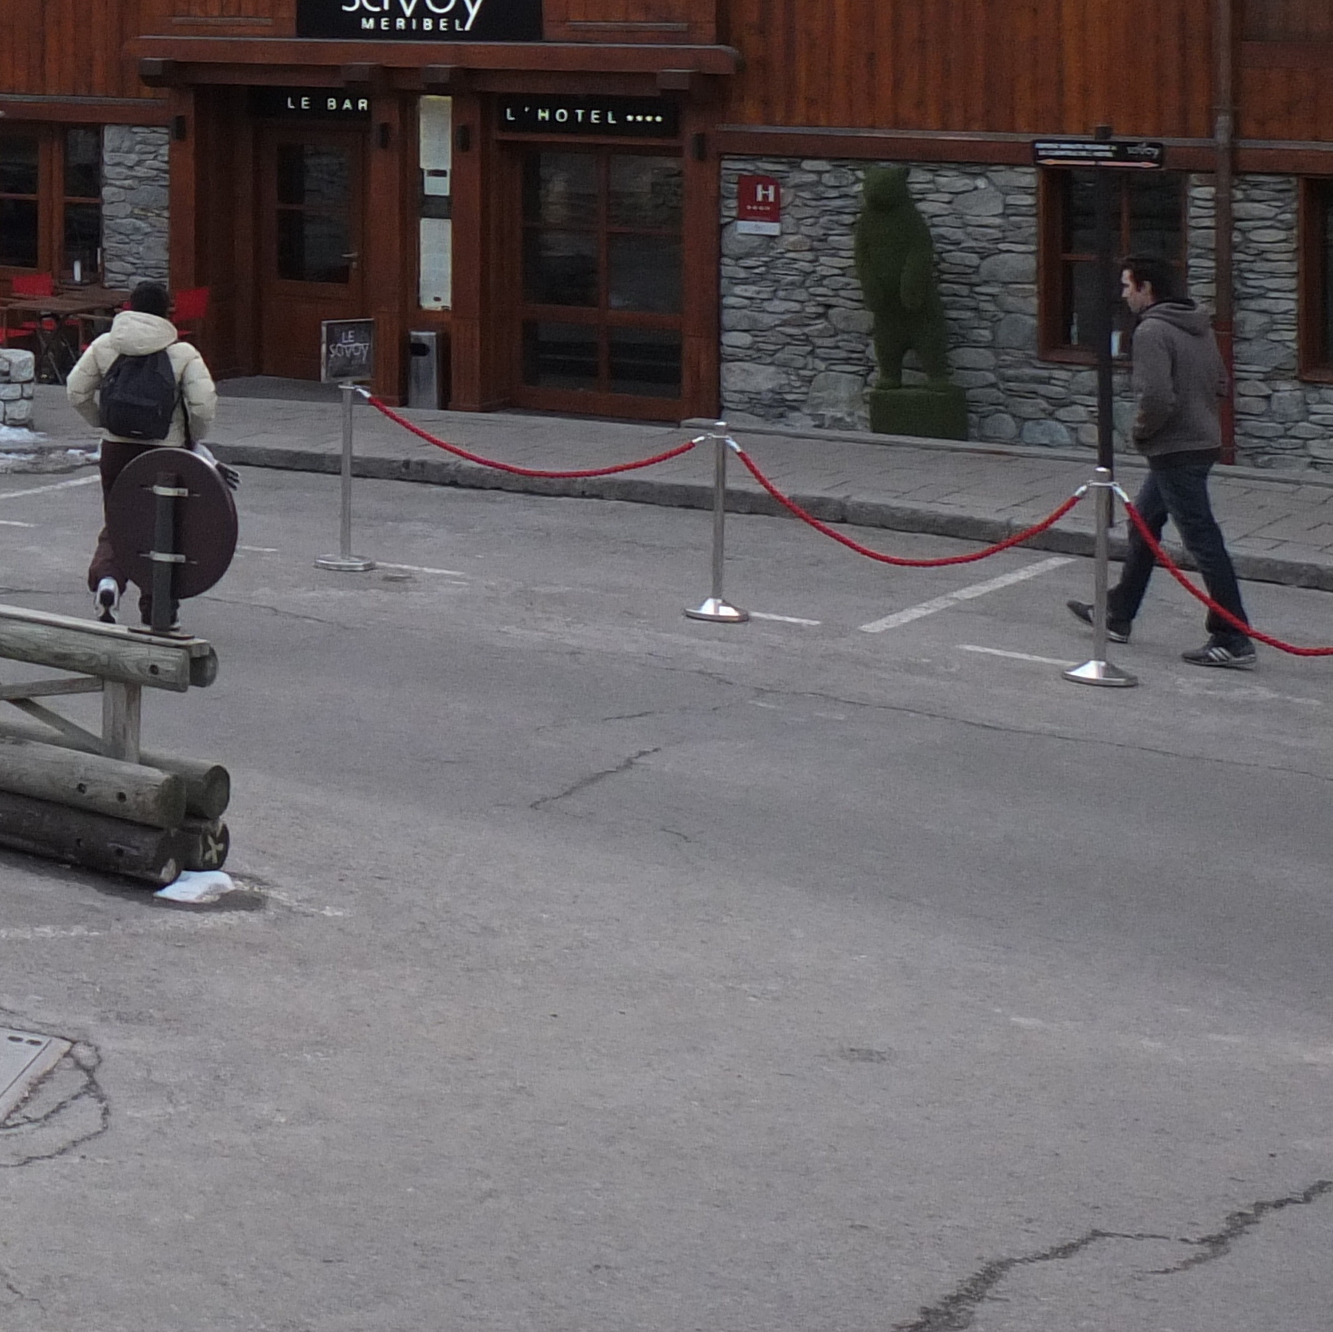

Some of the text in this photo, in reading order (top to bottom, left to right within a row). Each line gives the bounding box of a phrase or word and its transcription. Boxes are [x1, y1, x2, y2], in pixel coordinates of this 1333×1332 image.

[361, 17, 465, 31] MERIBEL
[287, 97, 368, 111] LE BAR
[505, 106, 618, 125] L'HOTEL
[756, 184, 775, 202] H
[341, 329, 355, 344] LE
